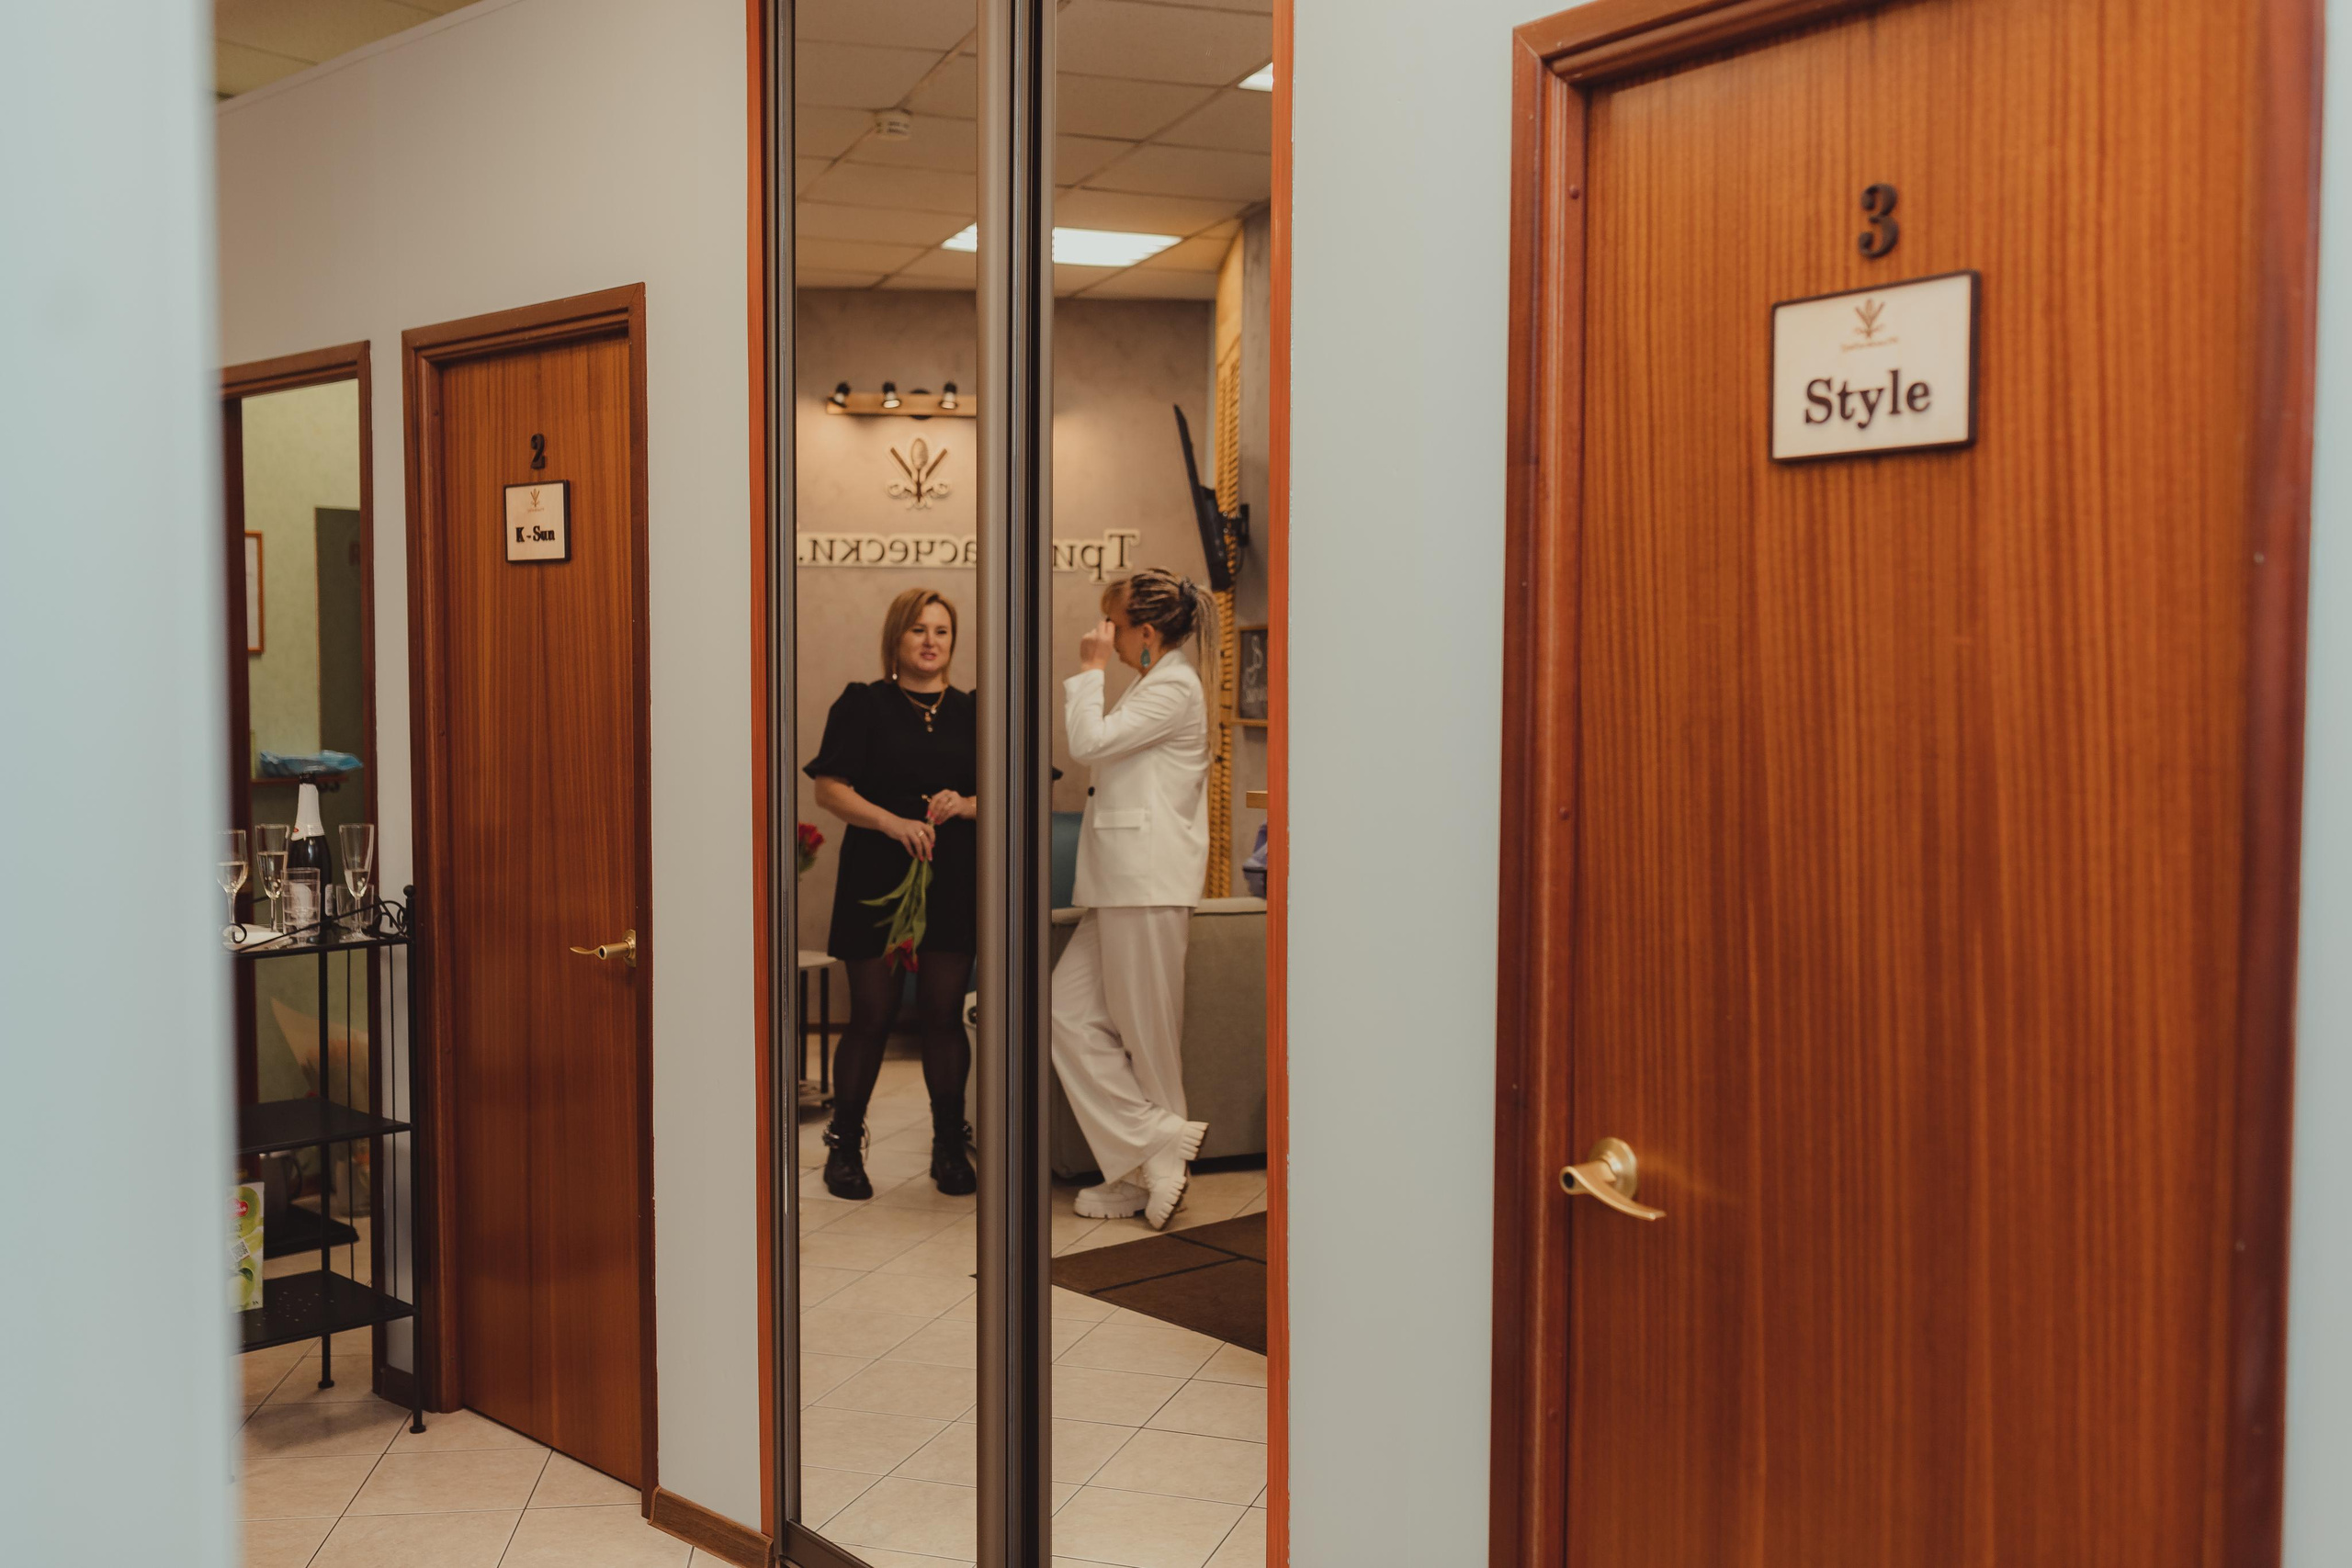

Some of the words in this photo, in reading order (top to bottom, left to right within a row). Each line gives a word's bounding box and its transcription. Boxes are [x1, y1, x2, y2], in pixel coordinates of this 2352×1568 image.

[1859, 183, 1899, 258] 3
[1805, 369, 1931, 428] Style
[531, 434, 546, 469] 2
